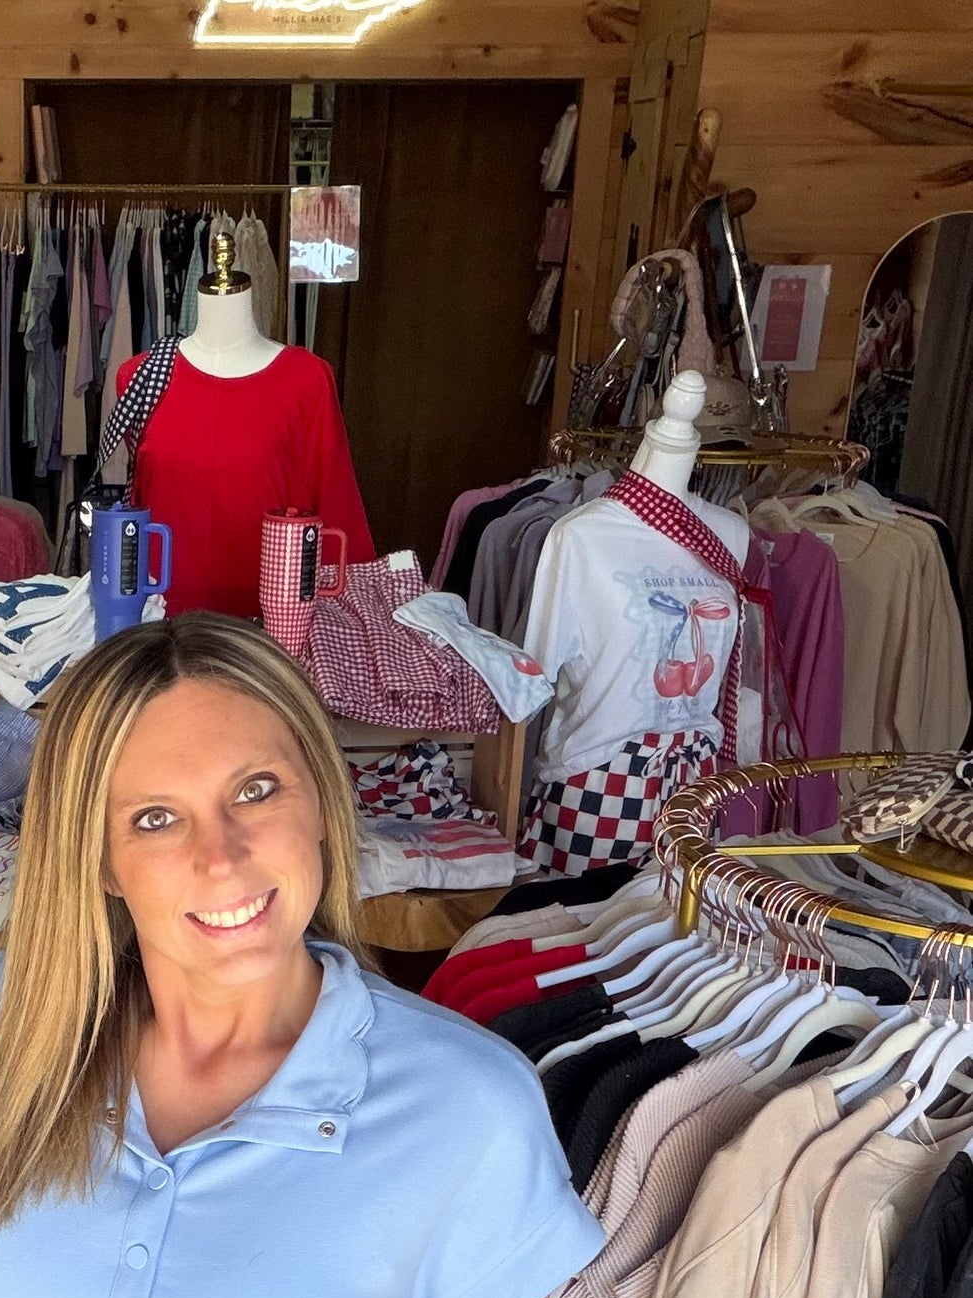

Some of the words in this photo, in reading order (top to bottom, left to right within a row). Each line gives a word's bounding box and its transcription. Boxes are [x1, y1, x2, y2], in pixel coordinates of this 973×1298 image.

[272, 15, 306, 23] MILLIE
[311, 15, 341, 23] MAE'S
[644, 578, 675, 587] SHOP
[680, 577, 719, 587] SMALL
